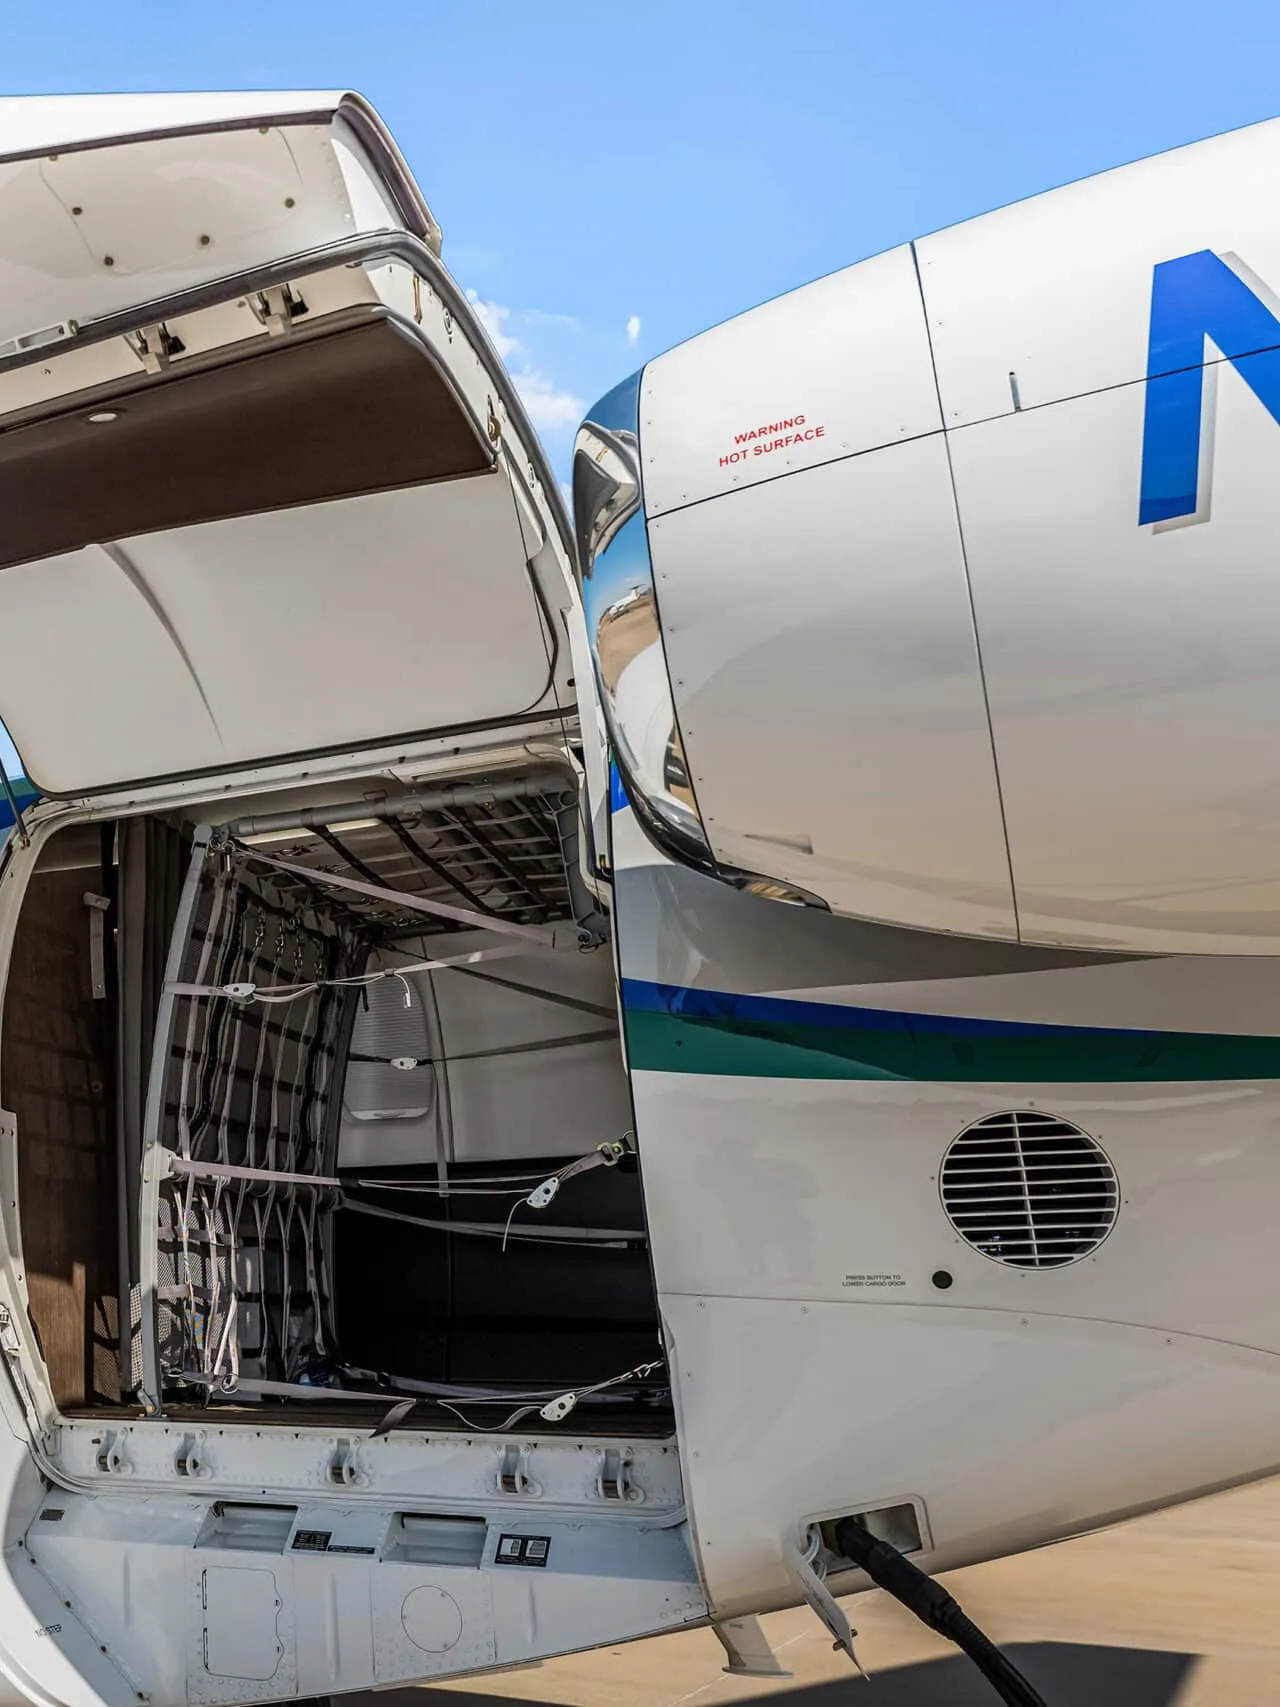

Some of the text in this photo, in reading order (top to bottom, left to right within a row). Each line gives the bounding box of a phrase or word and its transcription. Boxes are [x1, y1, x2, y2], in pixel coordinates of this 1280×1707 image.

[719, 426, 825, 467] HOT SURFACE
[734, 415, 806, 444] WARNING
